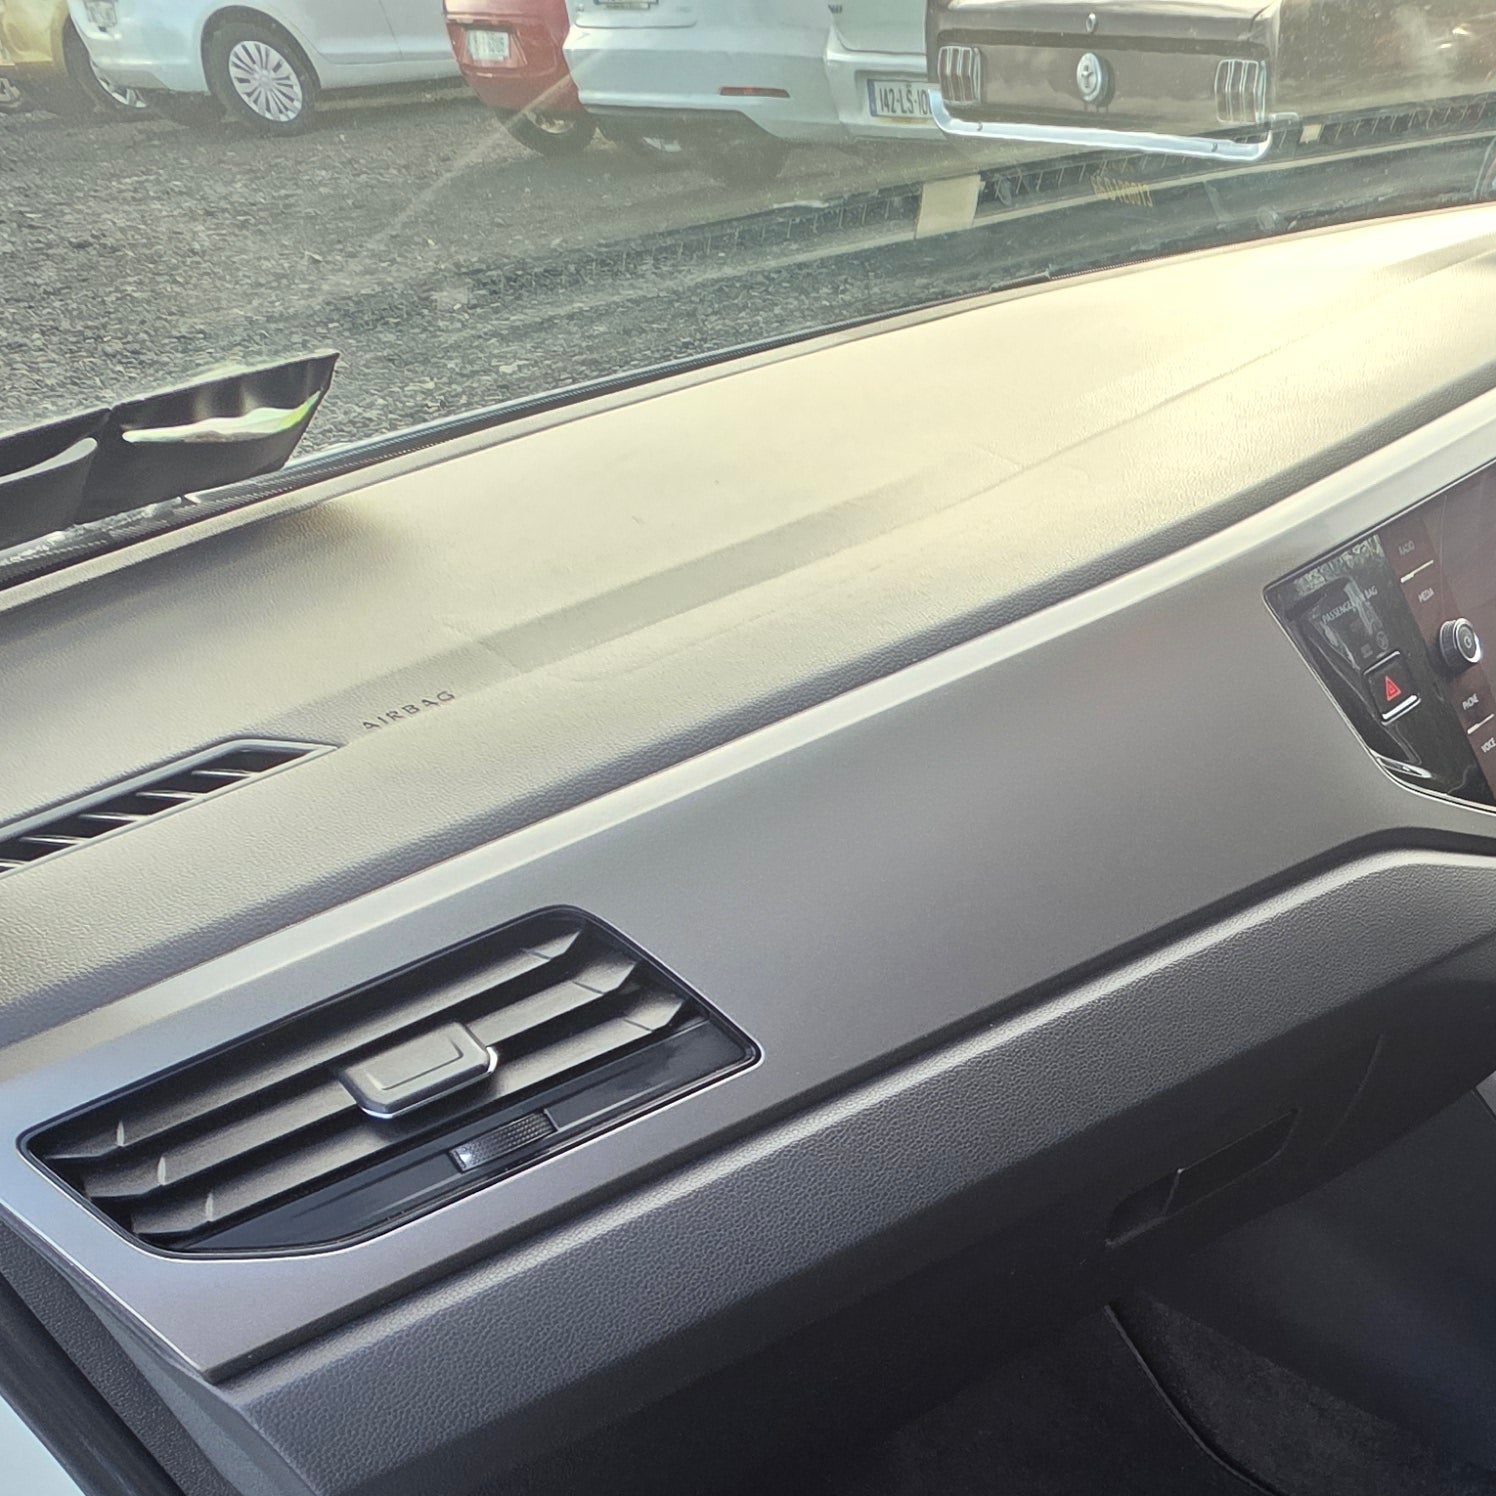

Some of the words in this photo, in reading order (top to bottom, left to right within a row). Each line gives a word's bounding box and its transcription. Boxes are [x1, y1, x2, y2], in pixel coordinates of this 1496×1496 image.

[1398, 540, 1416, 556] RADIO
[1418, 587, 1435, 603] MEDIA
[362, 690, 456, 730] AIRBAG
[1481, 737, 1496, 753] VOICE
